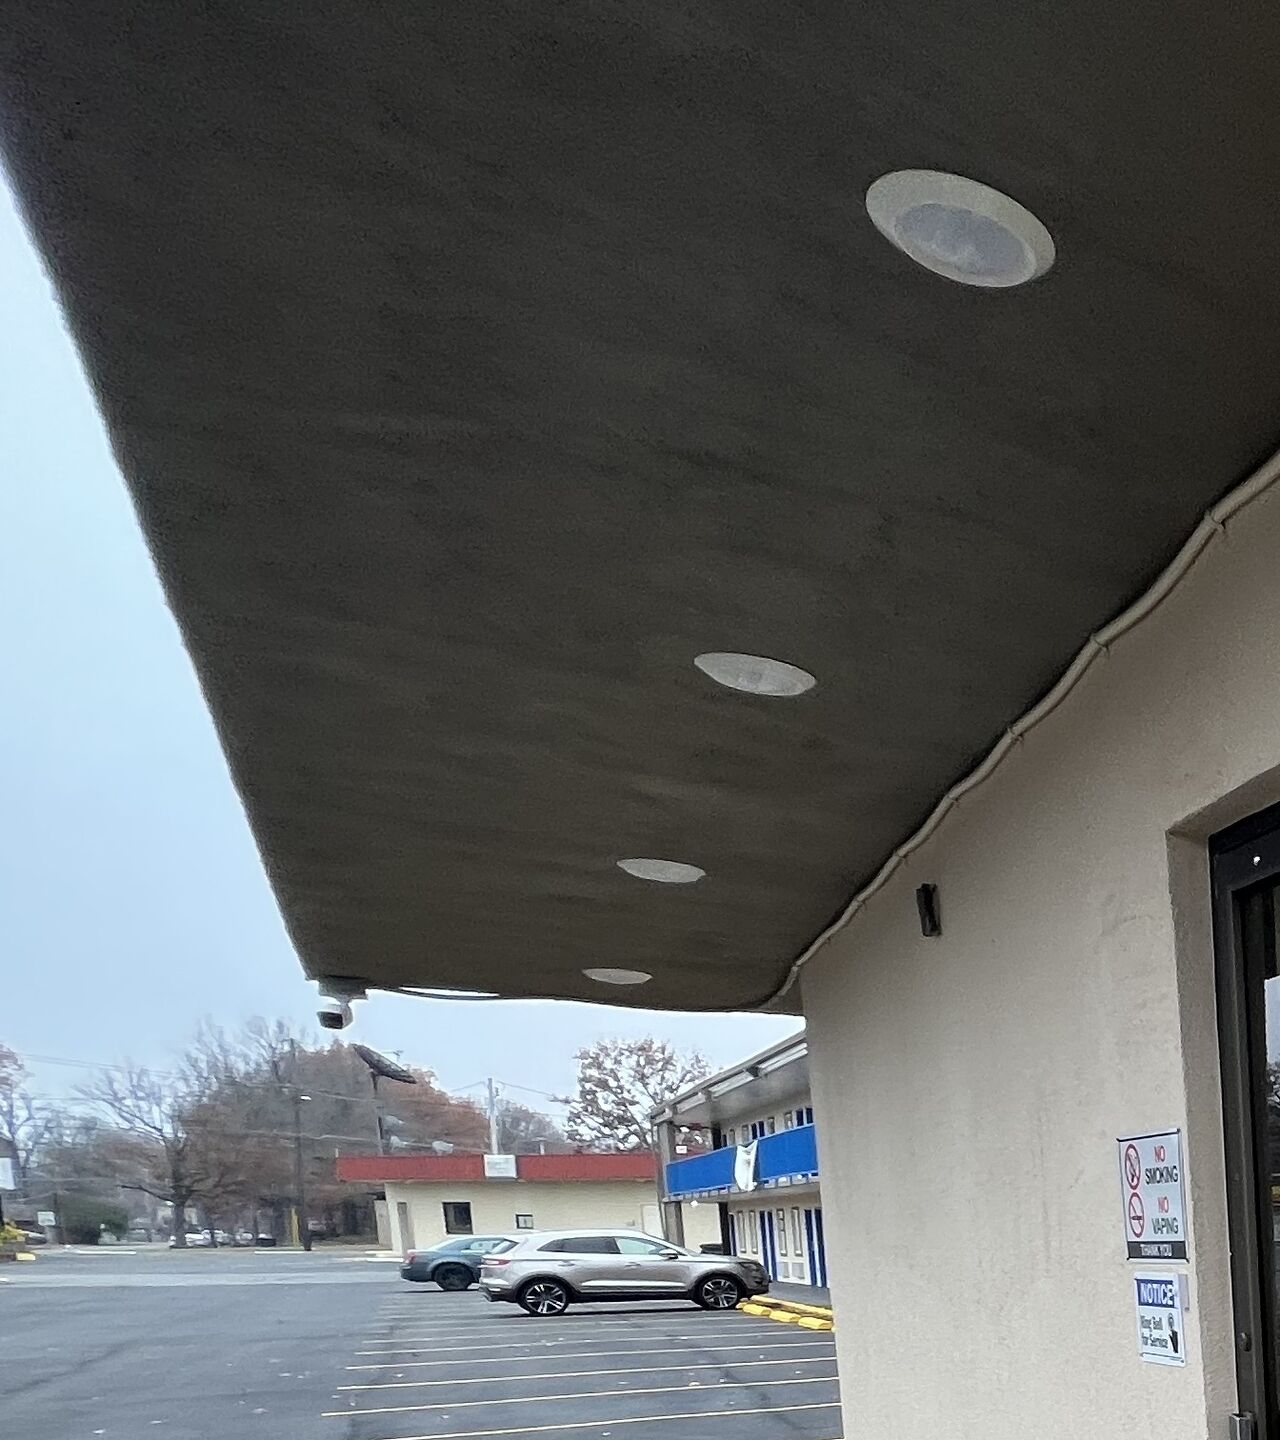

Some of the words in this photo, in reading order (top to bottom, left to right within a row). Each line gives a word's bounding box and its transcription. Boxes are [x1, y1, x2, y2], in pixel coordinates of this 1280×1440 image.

[1154, 1145, 1165, 1162] NO
[1145, 1165, 1178, 1185] SMOKING
[1158, 1196, 1169, 1213] NO
[1151, 1217, 1178, 1234] VAPING
[1140, 1282, 1174, 1306] NOTICE
